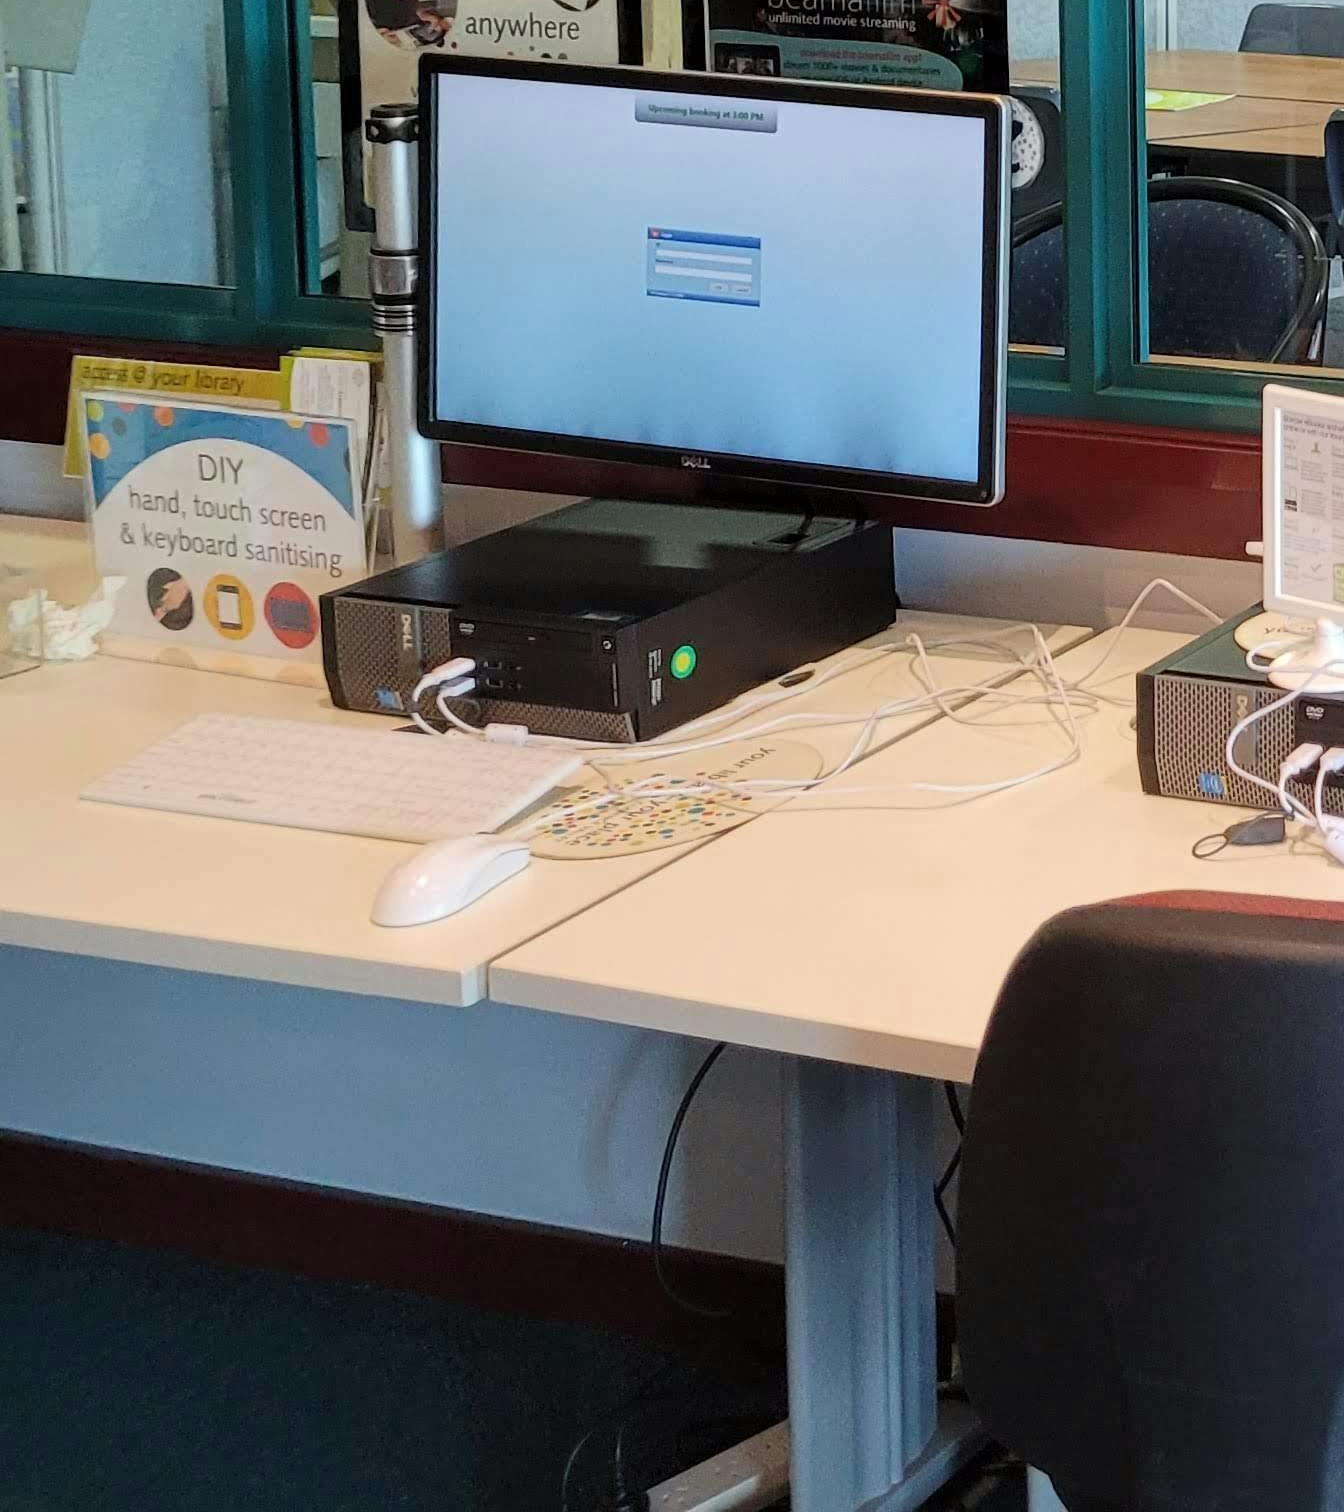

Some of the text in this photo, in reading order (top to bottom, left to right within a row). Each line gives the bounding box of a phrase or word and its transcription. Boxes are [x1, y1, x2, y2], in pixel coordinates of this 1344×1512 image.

[465, 12, 580, 43] anywhere
[769, 11, 916, 32] unlimited movie streaming
[198, 454, 244, 485] DIY
[128, 485, 326, 532] hand, touch screen
[120, 523, 343, 578] & keyboard sanitising
